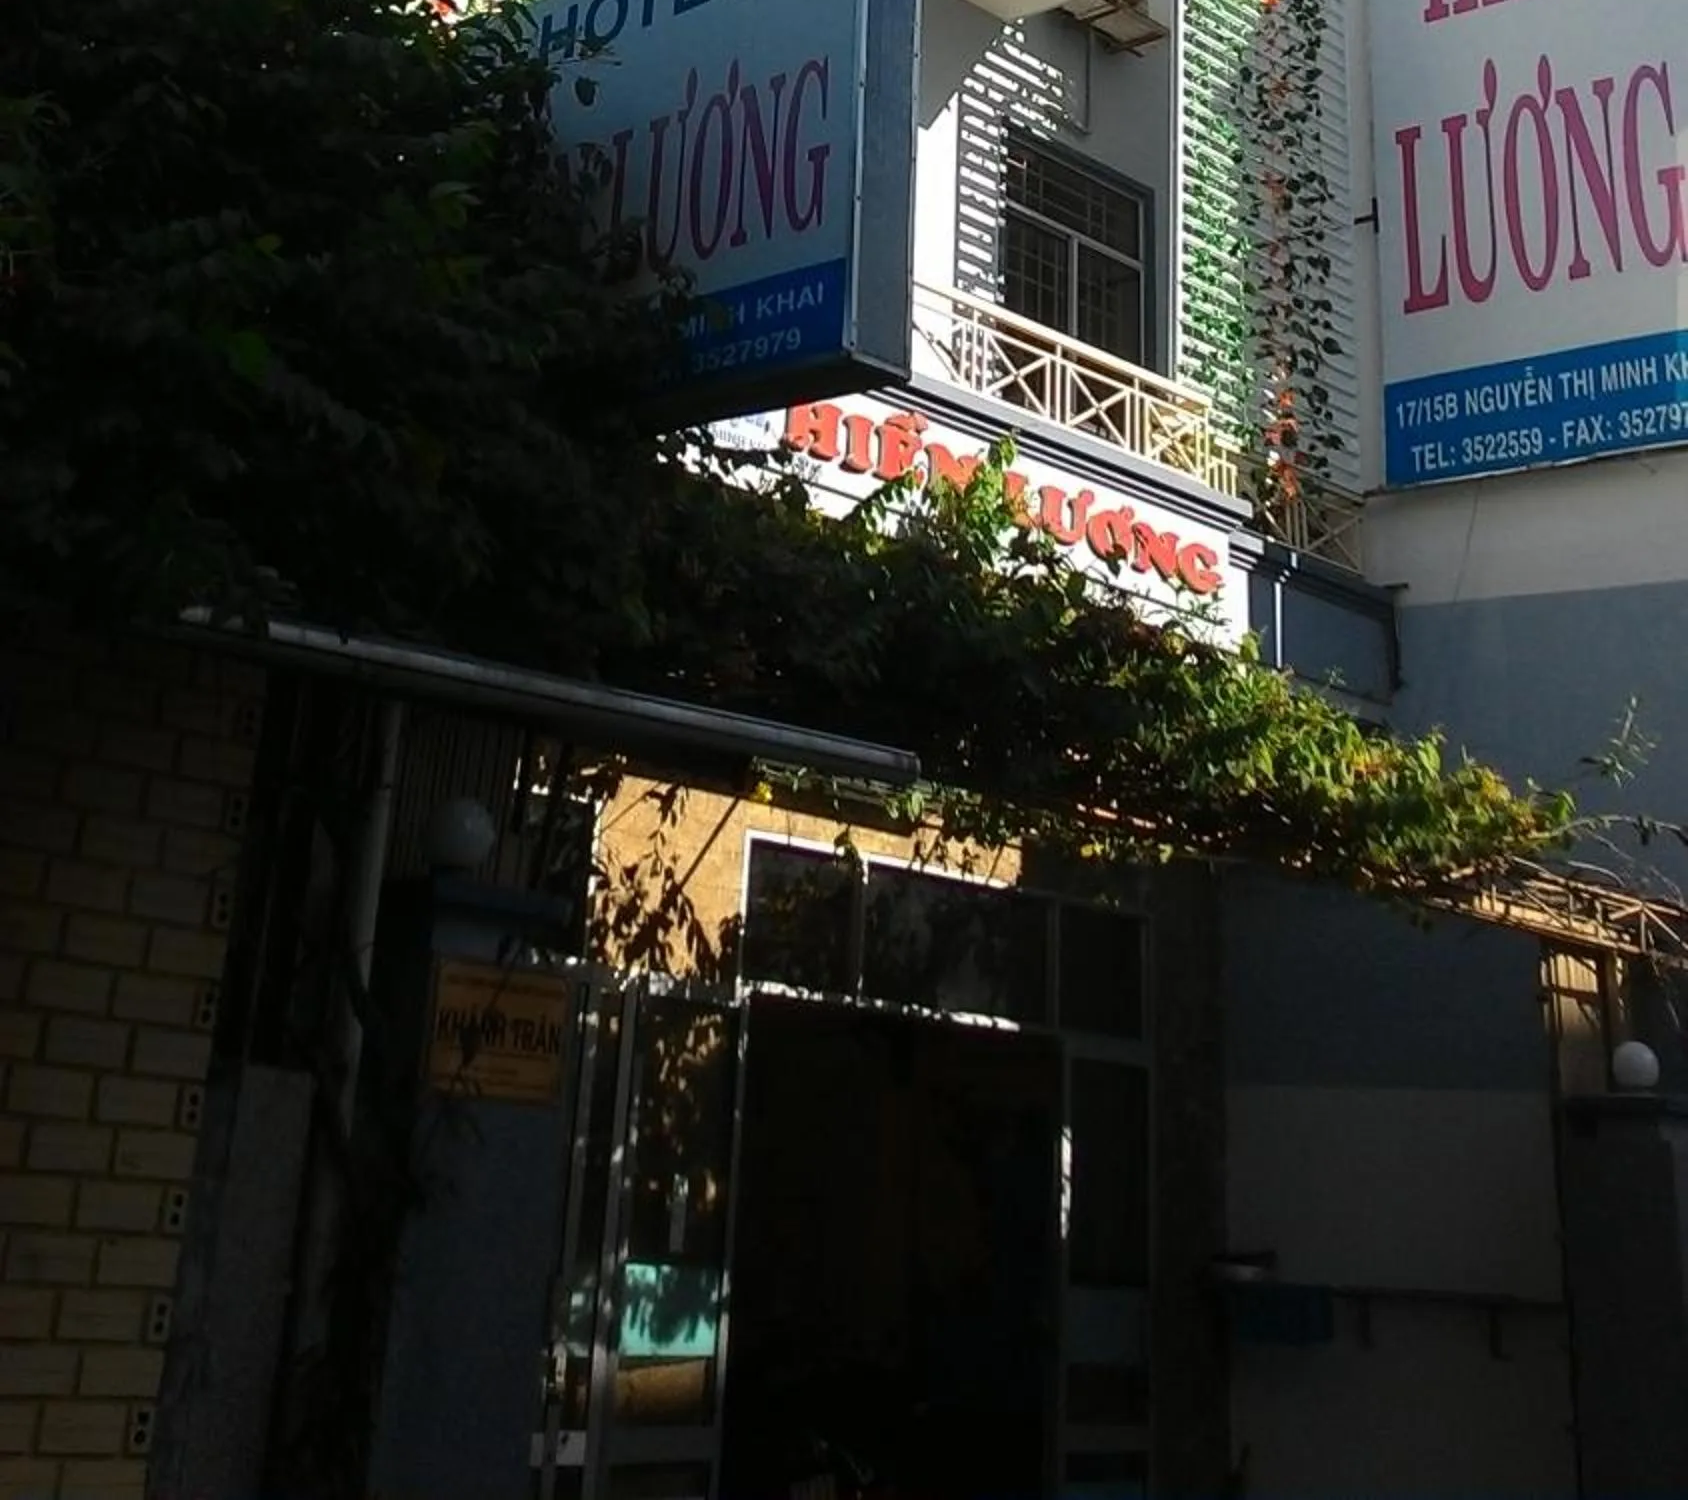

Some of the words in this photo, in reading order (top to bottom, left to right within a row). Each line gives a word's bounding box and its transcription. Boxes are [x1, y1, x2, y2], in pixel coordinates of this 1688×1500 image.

[1394, 54, 1688, 315] LƯƠNG
[756, 280, 824, 320] KHAI
[1396, 391, 1458, 429] 17/15B
[1559, 368, 1595, 402] THỊ
[1601, 355, 1658, 393] MINH
[1411, 441, 1456, 474] TEL:
[1461, 426, 1543, 464] 3522559
[1562, 412, 1613, 449] FAX:
